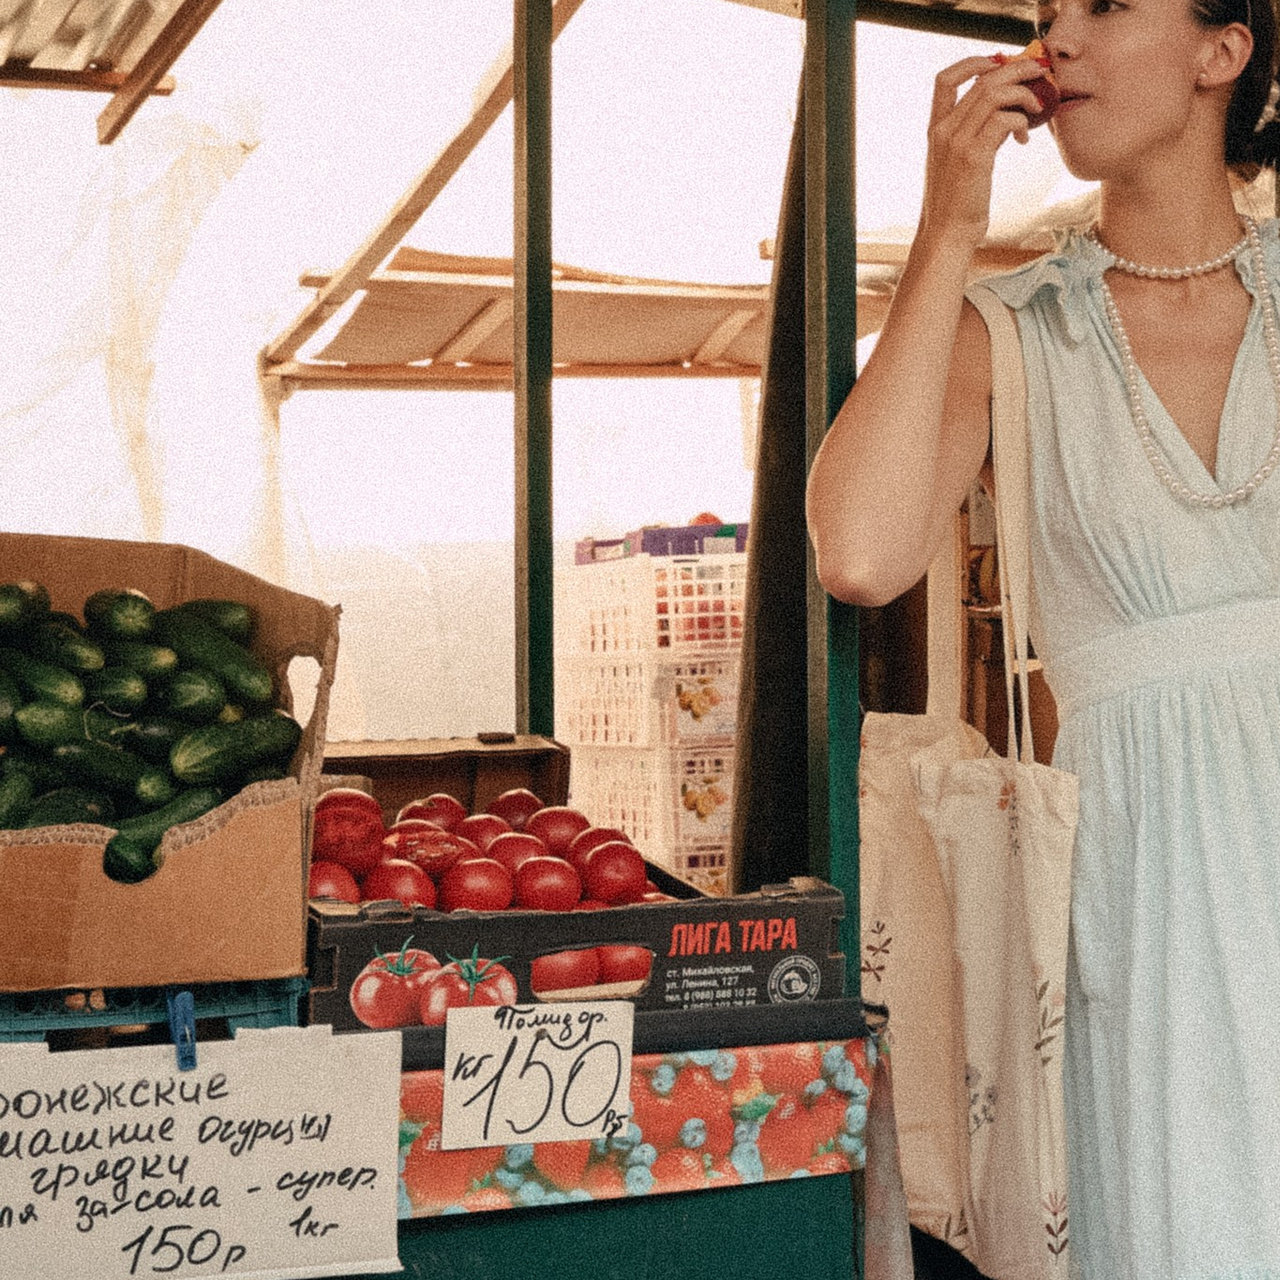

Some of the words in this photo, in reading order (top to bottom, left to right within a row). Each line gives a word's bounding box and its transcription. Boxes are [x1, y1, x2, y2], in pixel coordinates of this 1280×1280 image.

[667, 921, 732, 957] ЛИГА
[738, 917, 798, 953] ТАРА
[721, 976, 739, 986] 127
[734, 987, 745, 998] 10
[463, 1028, 622, 1141] 150
[30, 1154, 189, 1202] грядки
